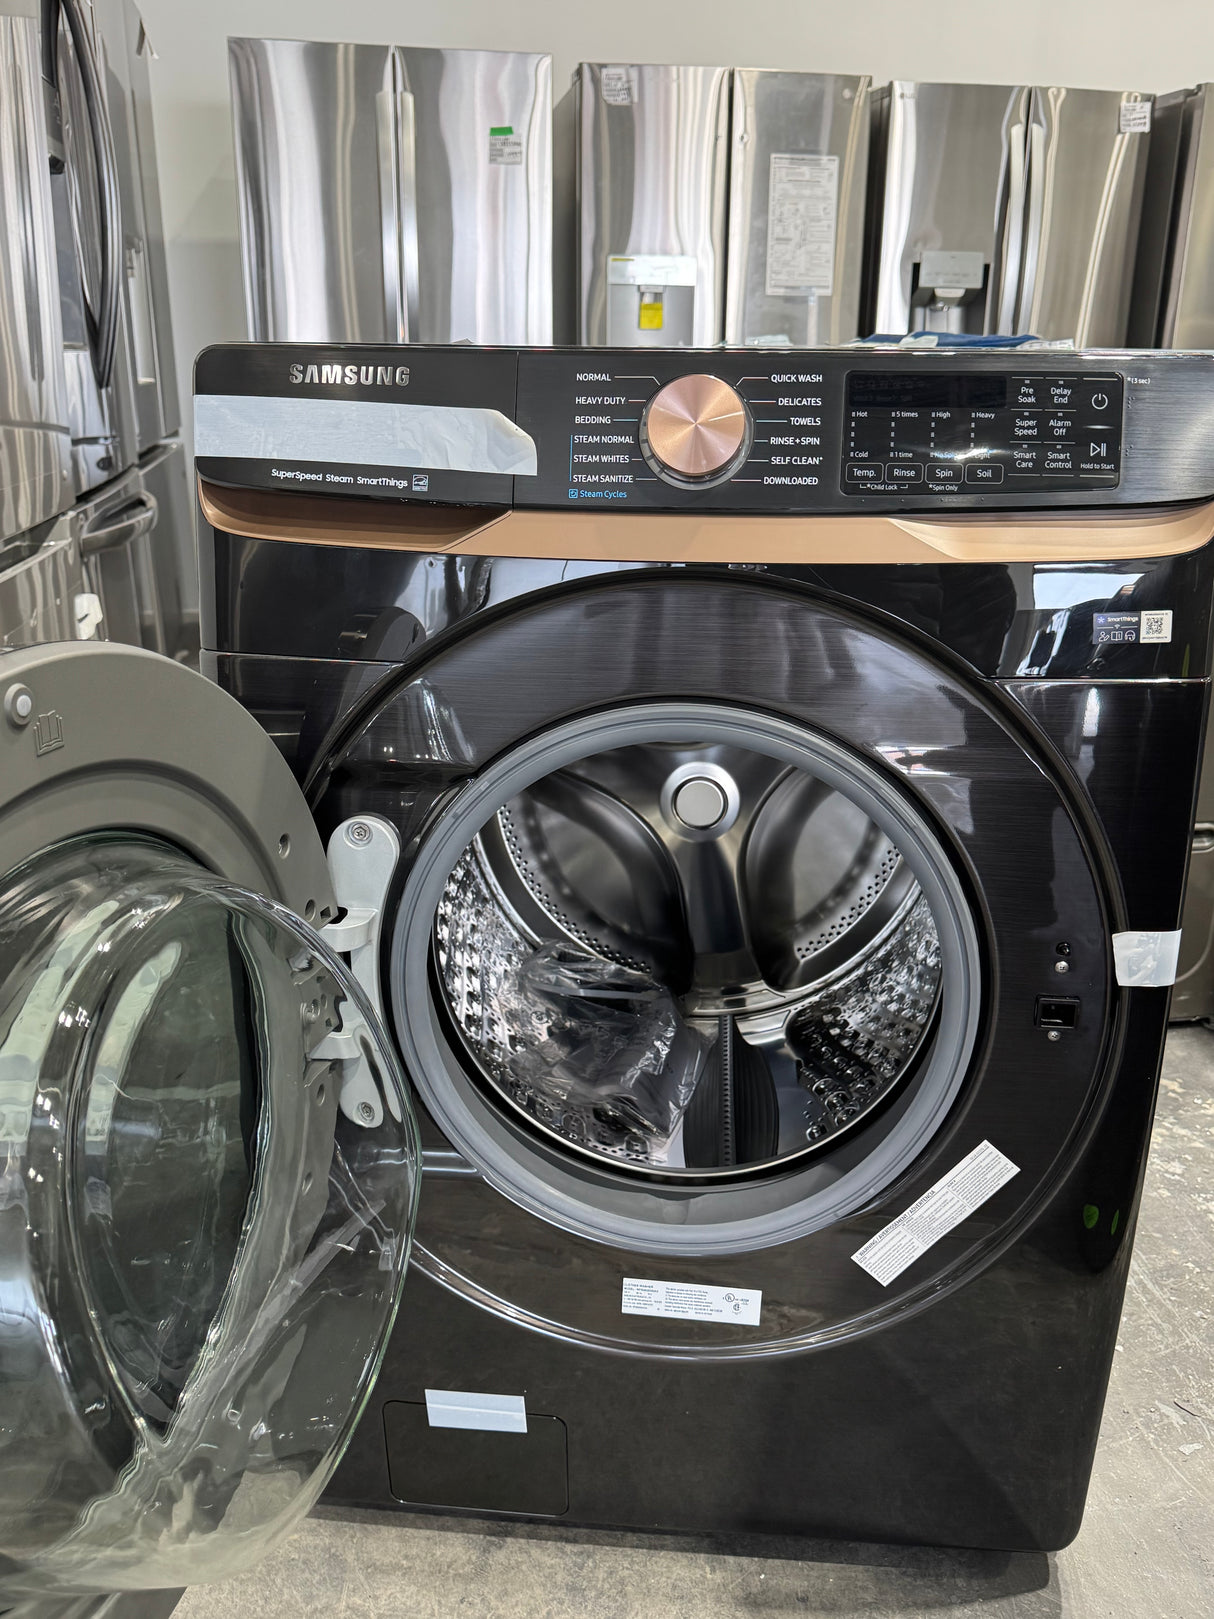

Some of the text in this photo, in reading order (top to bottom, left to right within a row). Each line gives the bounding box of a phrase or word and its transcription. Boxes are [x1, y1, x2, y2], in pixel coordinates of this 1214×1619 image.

[289, 364, 410, 386] SAMSUNG
[576, 373, 612, 382] NORMAL
[770, 374, 822, 383] QUICK WASH
[1051, 387, 1071, 396] Delay
[576, 396, 626, 405] HEAVY DUTY
[778, 398, 822, 406] DELICATES
[1018, 395, 1036, 403] Soak
[575, 416, 611, 424] BEDDING
[790, 417, 821, 426] TOWELS
[1016, 419, 1037, 427] Super
[1015, 428, 1037, 436] Speed
[574, 436, 634, 444] STEAM NORMAL
[574, 454, 600, 462] STEAM
[771, 456, 790, 464] SELF
[1045, 461, 1072, 469] Control
[853, 469, 876, 477] Temp.
[936, 470, 953, 478] Spin
[977, 470, 992, 478] Soil
[271, 468, 323, 482] SuperSpeed
[325, 474, 353, 484] Steam
[357, 475, 408, 489] SmartThings
[573, 474, 633, 483] STEAM SANITIZE
[764, 476, 818, 485] DOWNLOADED
[580, 490, 627, 499] Steam Cycles
[859, 1240, 878, 1257] WARNING
